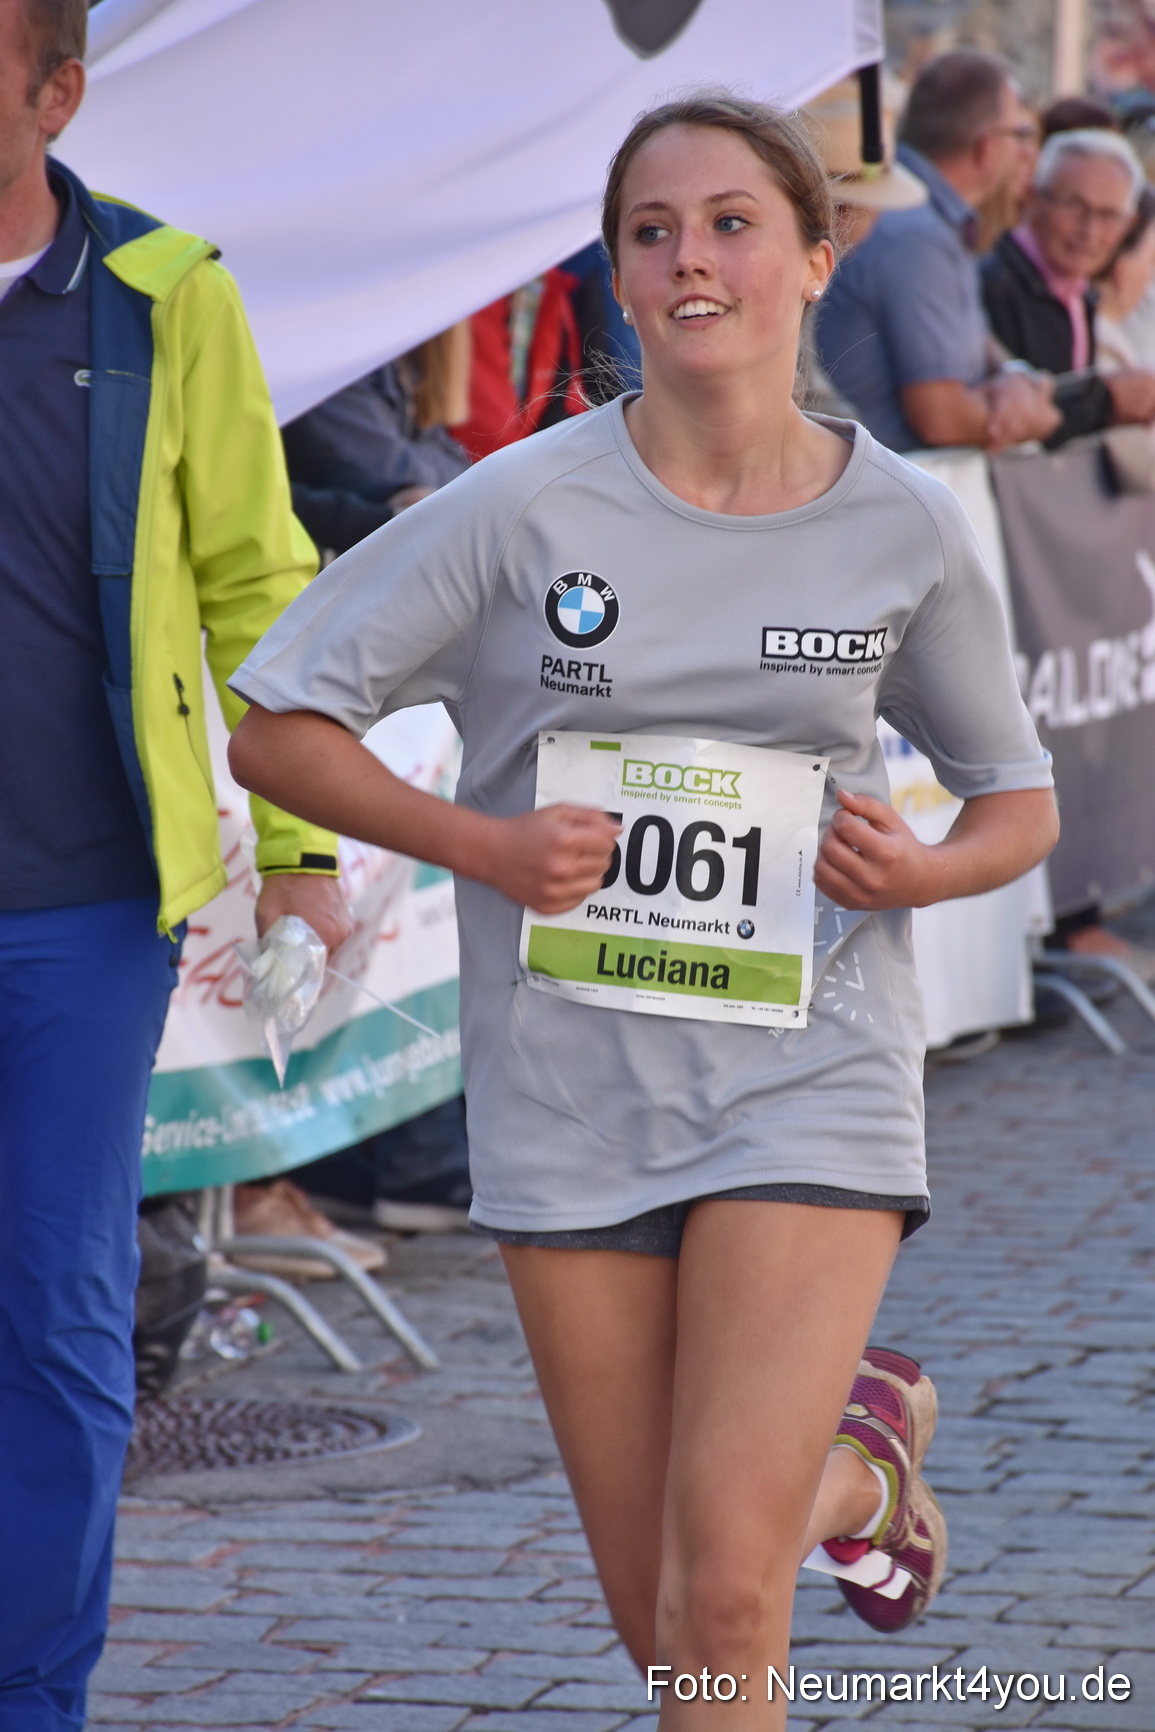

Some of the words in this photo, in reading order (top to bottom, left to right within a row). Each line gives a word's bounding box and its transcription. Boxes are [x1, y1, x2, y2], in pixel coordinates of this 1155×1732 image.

[553, 573, 615, 602] BMW
[762, 627, 888, 662] BOCK
[541, 654, 613, 683] PARTL
[760, 660, 806, 673] inspired
[809, 663, 823, 676] by
[826, 666, 855, 676] smart
[540, 674, 612, 698] Neumarkt
[622, 759, 742, 799] BOCK
[621, 788, 657, 799] inspired
[660, 792, 671, 803] by
[674, 795, 701, 805] smart
[704, 799, 742, 809] concepts
[586, 904, 643, 925] PARTL
[648, 912, 730, 934] Neumarkt
[597, 942, 730, 989] Luciana
